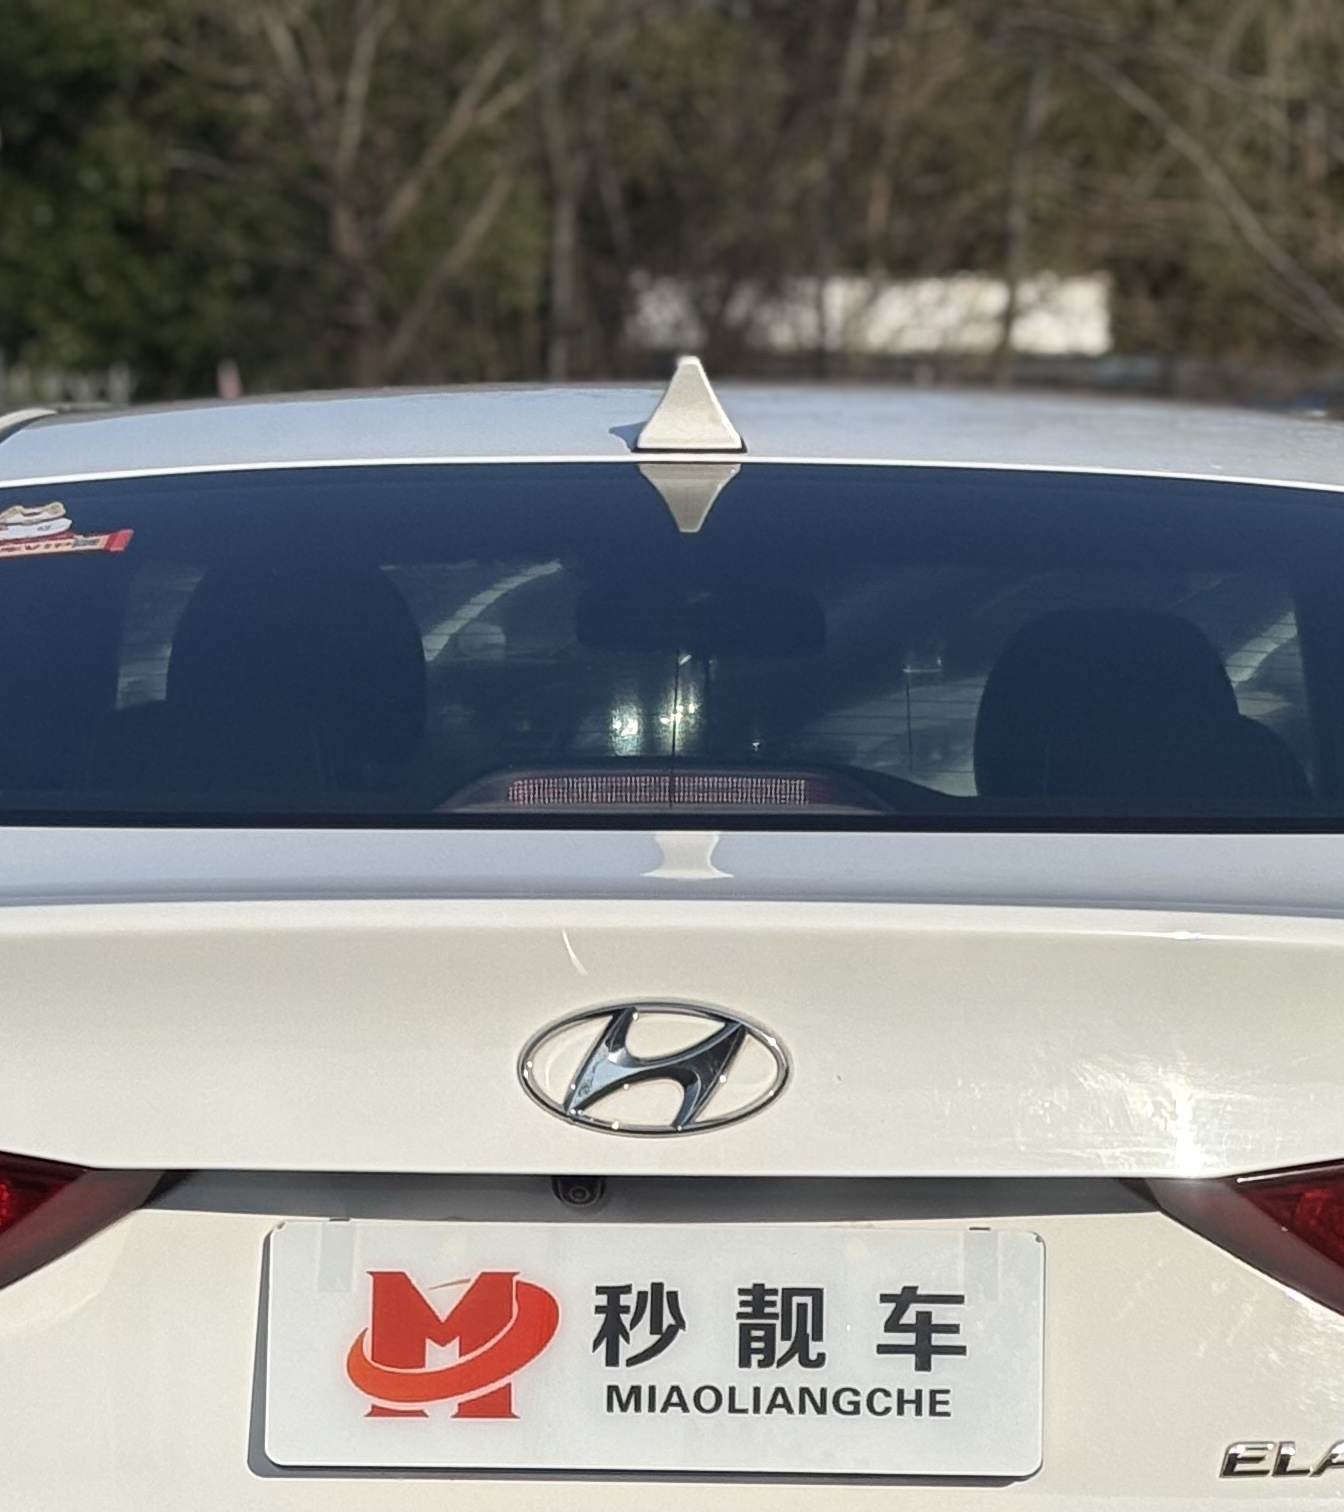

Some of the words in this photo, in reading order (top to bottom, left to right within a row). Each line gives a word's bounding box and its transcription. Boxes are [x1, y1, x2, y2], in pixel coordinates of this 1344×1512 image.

[591, 1281, 968, 1373] 秒靓车
[605, 1384, 952, 1418] MIAOLIANGCHE
